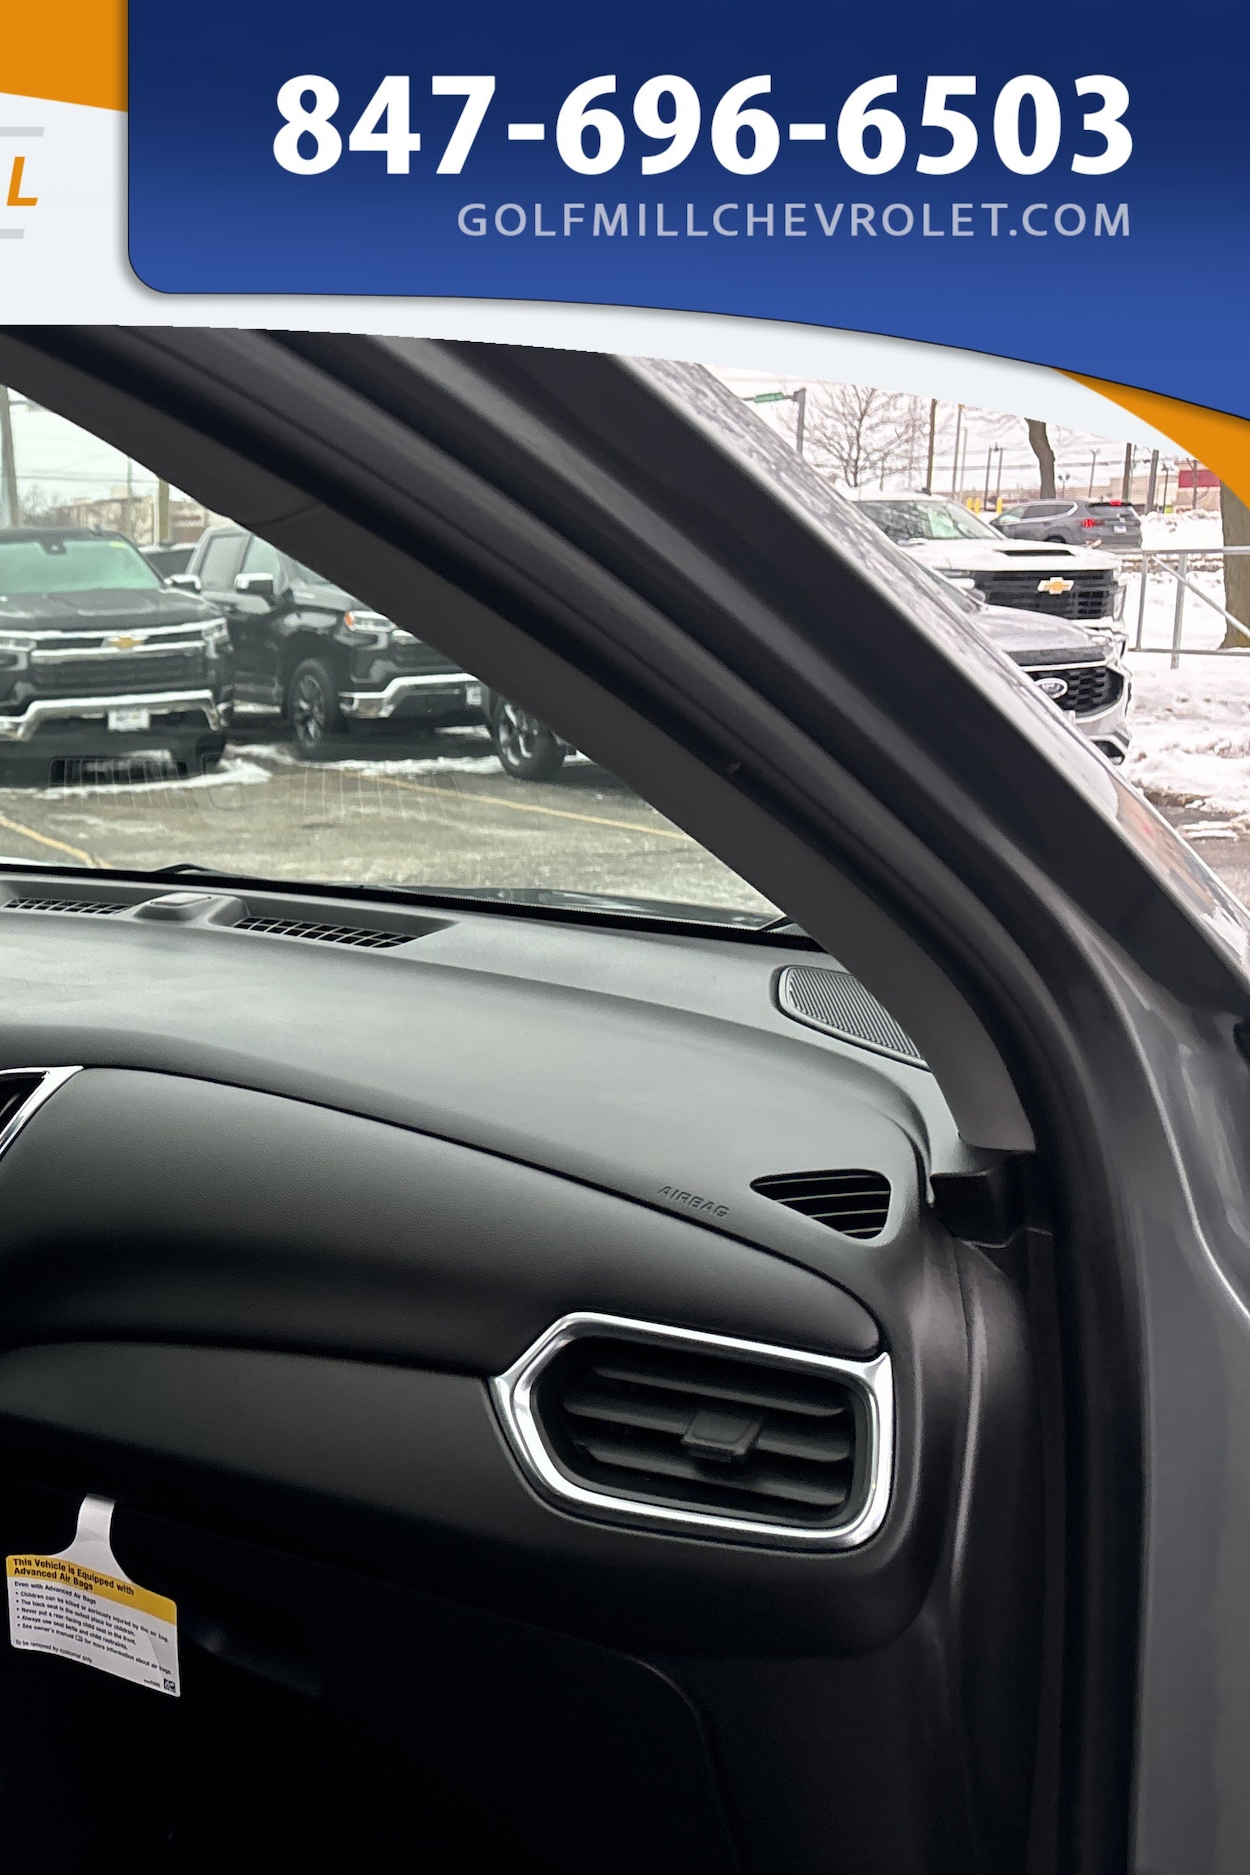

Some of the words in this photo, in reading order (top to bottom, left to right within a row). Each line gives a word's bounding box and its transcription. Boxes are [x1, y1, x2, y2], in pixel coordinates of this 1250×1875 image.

[658, 1185, 730, 1218] AIRBAG
[13, 1558, 32, 1566] This
[35, 1558, 66, 1571] Vehicle
[68, 1565, 75, 1574] is
[78, 1568, 114, 1588] Equipped
[116, 1584, 134, 1595] with
[14, 1568, 56, 1579] Advanced
[60, 1572, 71, 1582] Air
[74, 1577, 93, 1591] Bags
[45, 1585, 72, 1596] Advanced
[83, 1594, 96, 1605] Bags
[21, 1591, 44, 1599] Children
[66, 1599, 79, 1608] killed
[88, 1608, 111, 1620] seriously
[113, 1616, 131, 1627] injured
[140, 1625, 148, 1634] the
[75, 1611, 89, 1620] safest
[91, 1615, 104, 1625] place
[53, 1620, 64, 1628] seat
[66, 1624, 78, 1632] belts
[90, 1633, 101, 1641] child
[54, 1613, 82, 1626] rear-facing
[83, 1622, 95, 1630] child
[114, 1632, 122, 1640] the
[30, 1641, 51, 1650] removed
[60, 1648, 81, 1658] customer
[56, 1630, 74, 1639] manual
[93, 1642, 105, 1650] more
[107, 1646, 134, 1661] information
[136, 1657, 150, 1666] about
